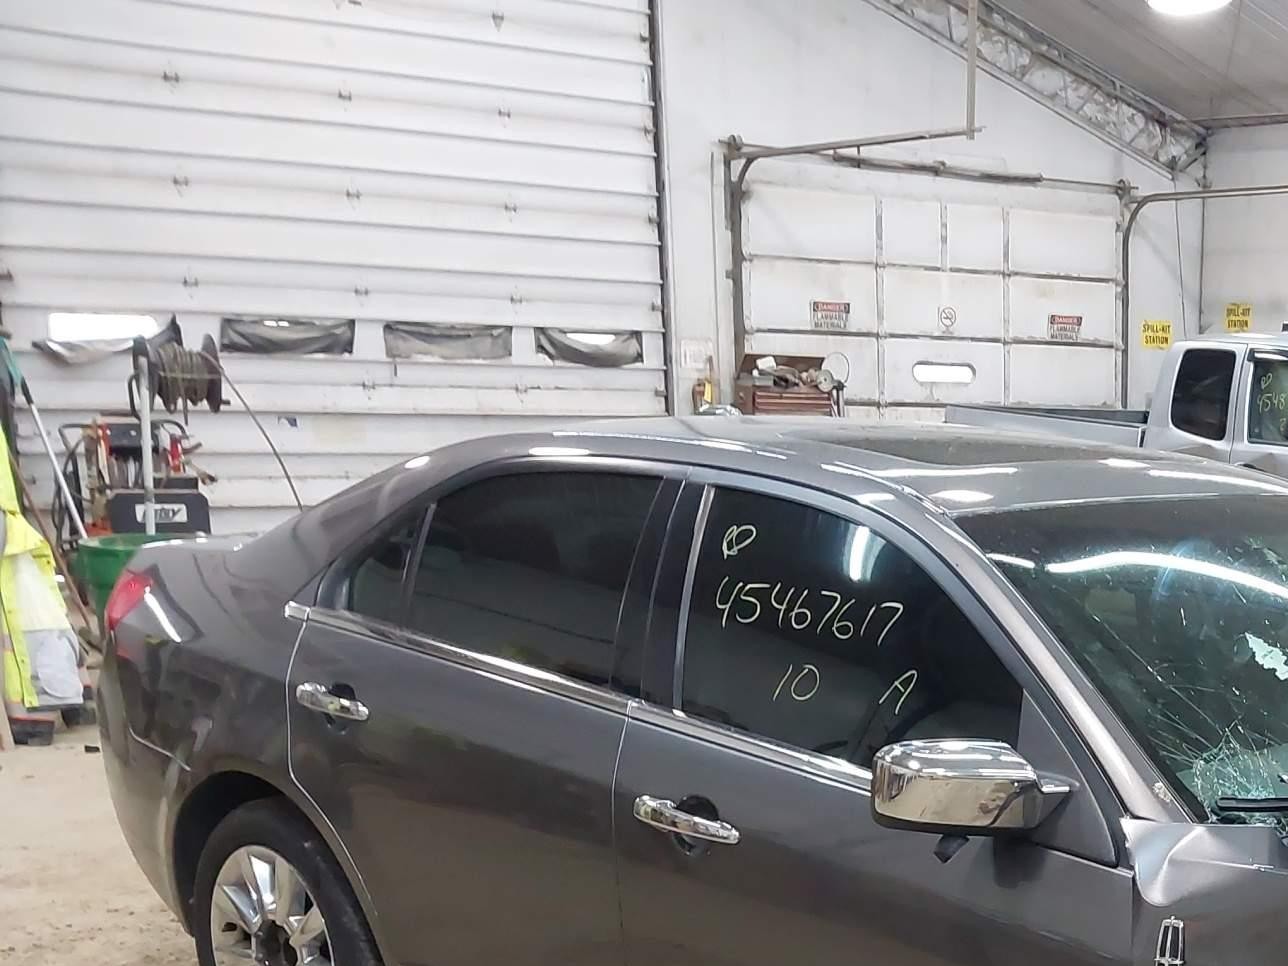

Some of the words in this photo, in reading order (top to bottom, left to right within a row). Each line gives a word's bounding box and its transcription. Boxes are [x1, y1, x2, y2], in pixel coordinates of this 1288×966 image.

[1142, 323, 1171, 334] SPILL-KIT
[1227, 319, 1249, 329] STATION
[1144, 335, 1169, 345] STATION
[715, 575, 904, 647] 45467617
[772, 664, 820, 701] 10
[878, 669, 918, 715] A
